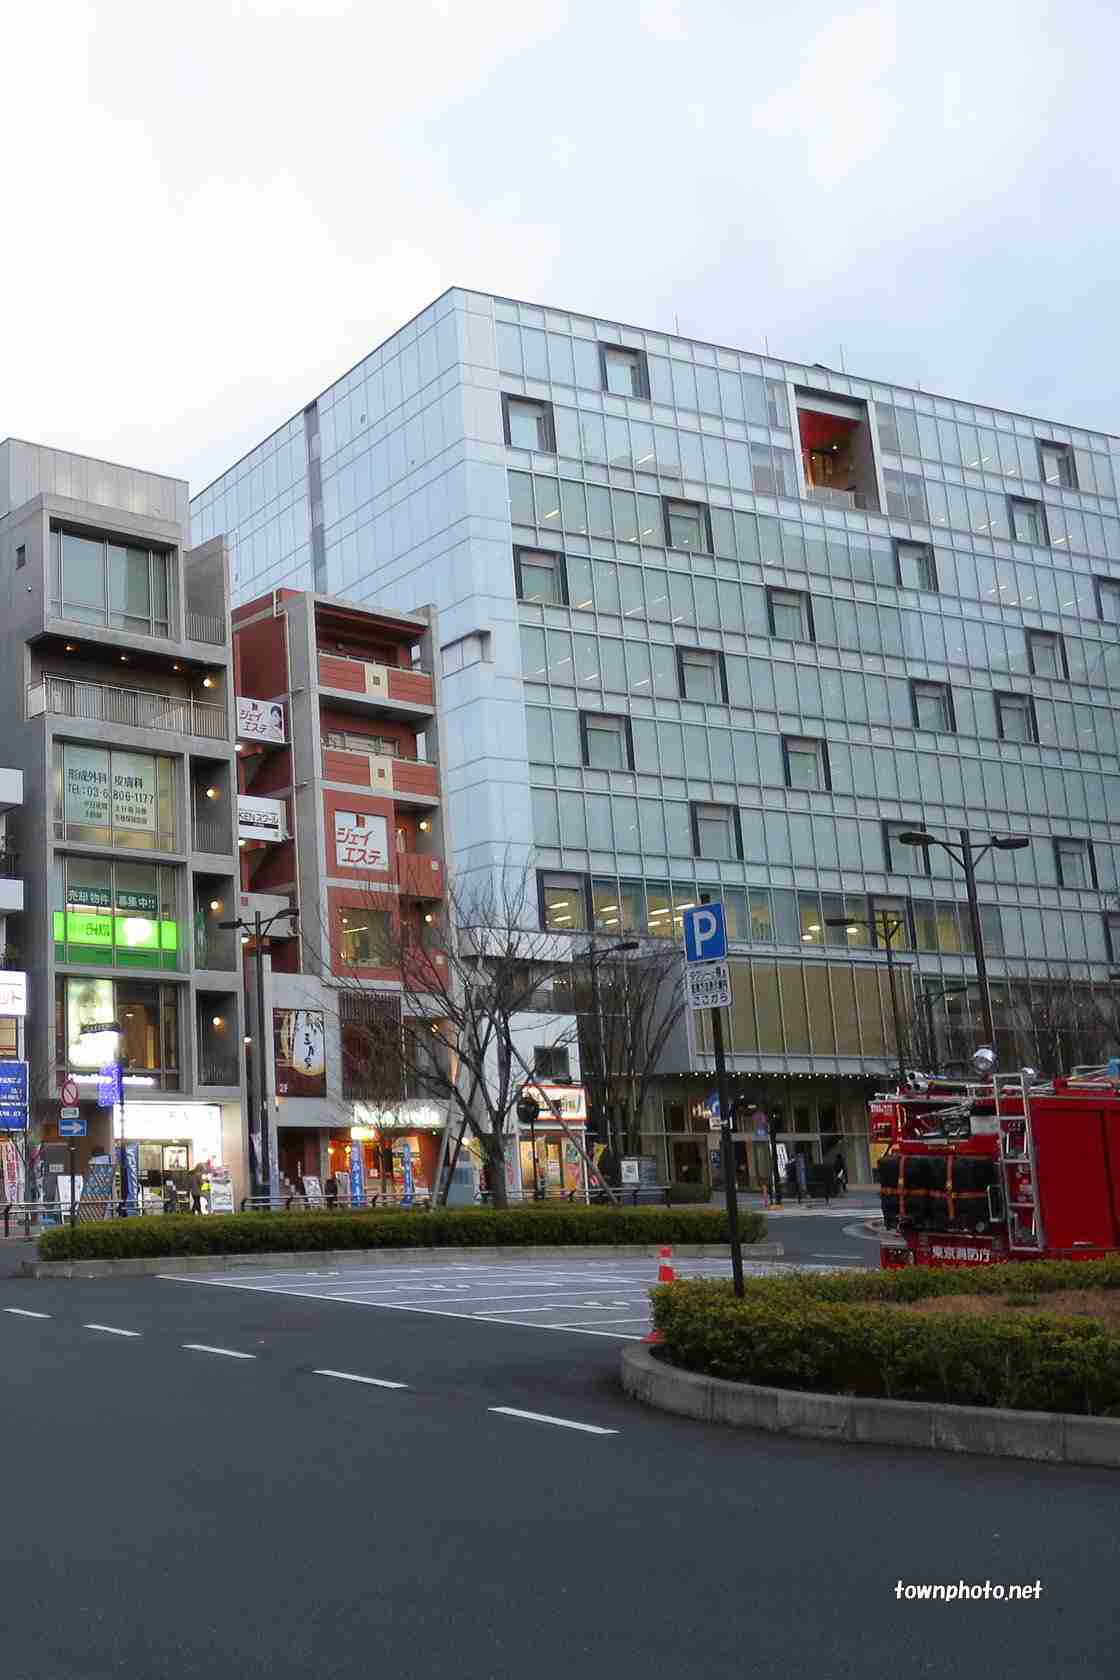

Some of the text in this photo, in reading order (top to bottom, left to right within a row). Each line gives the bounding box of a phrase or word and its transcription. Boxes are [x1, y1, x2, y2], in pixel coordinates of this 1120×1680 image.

[245, 721, 267, 733] エステ
[336, 827, 375, 846] ジェイ
[341, 847, 381, 865] エステ
[692, 911, 716, 957] P
